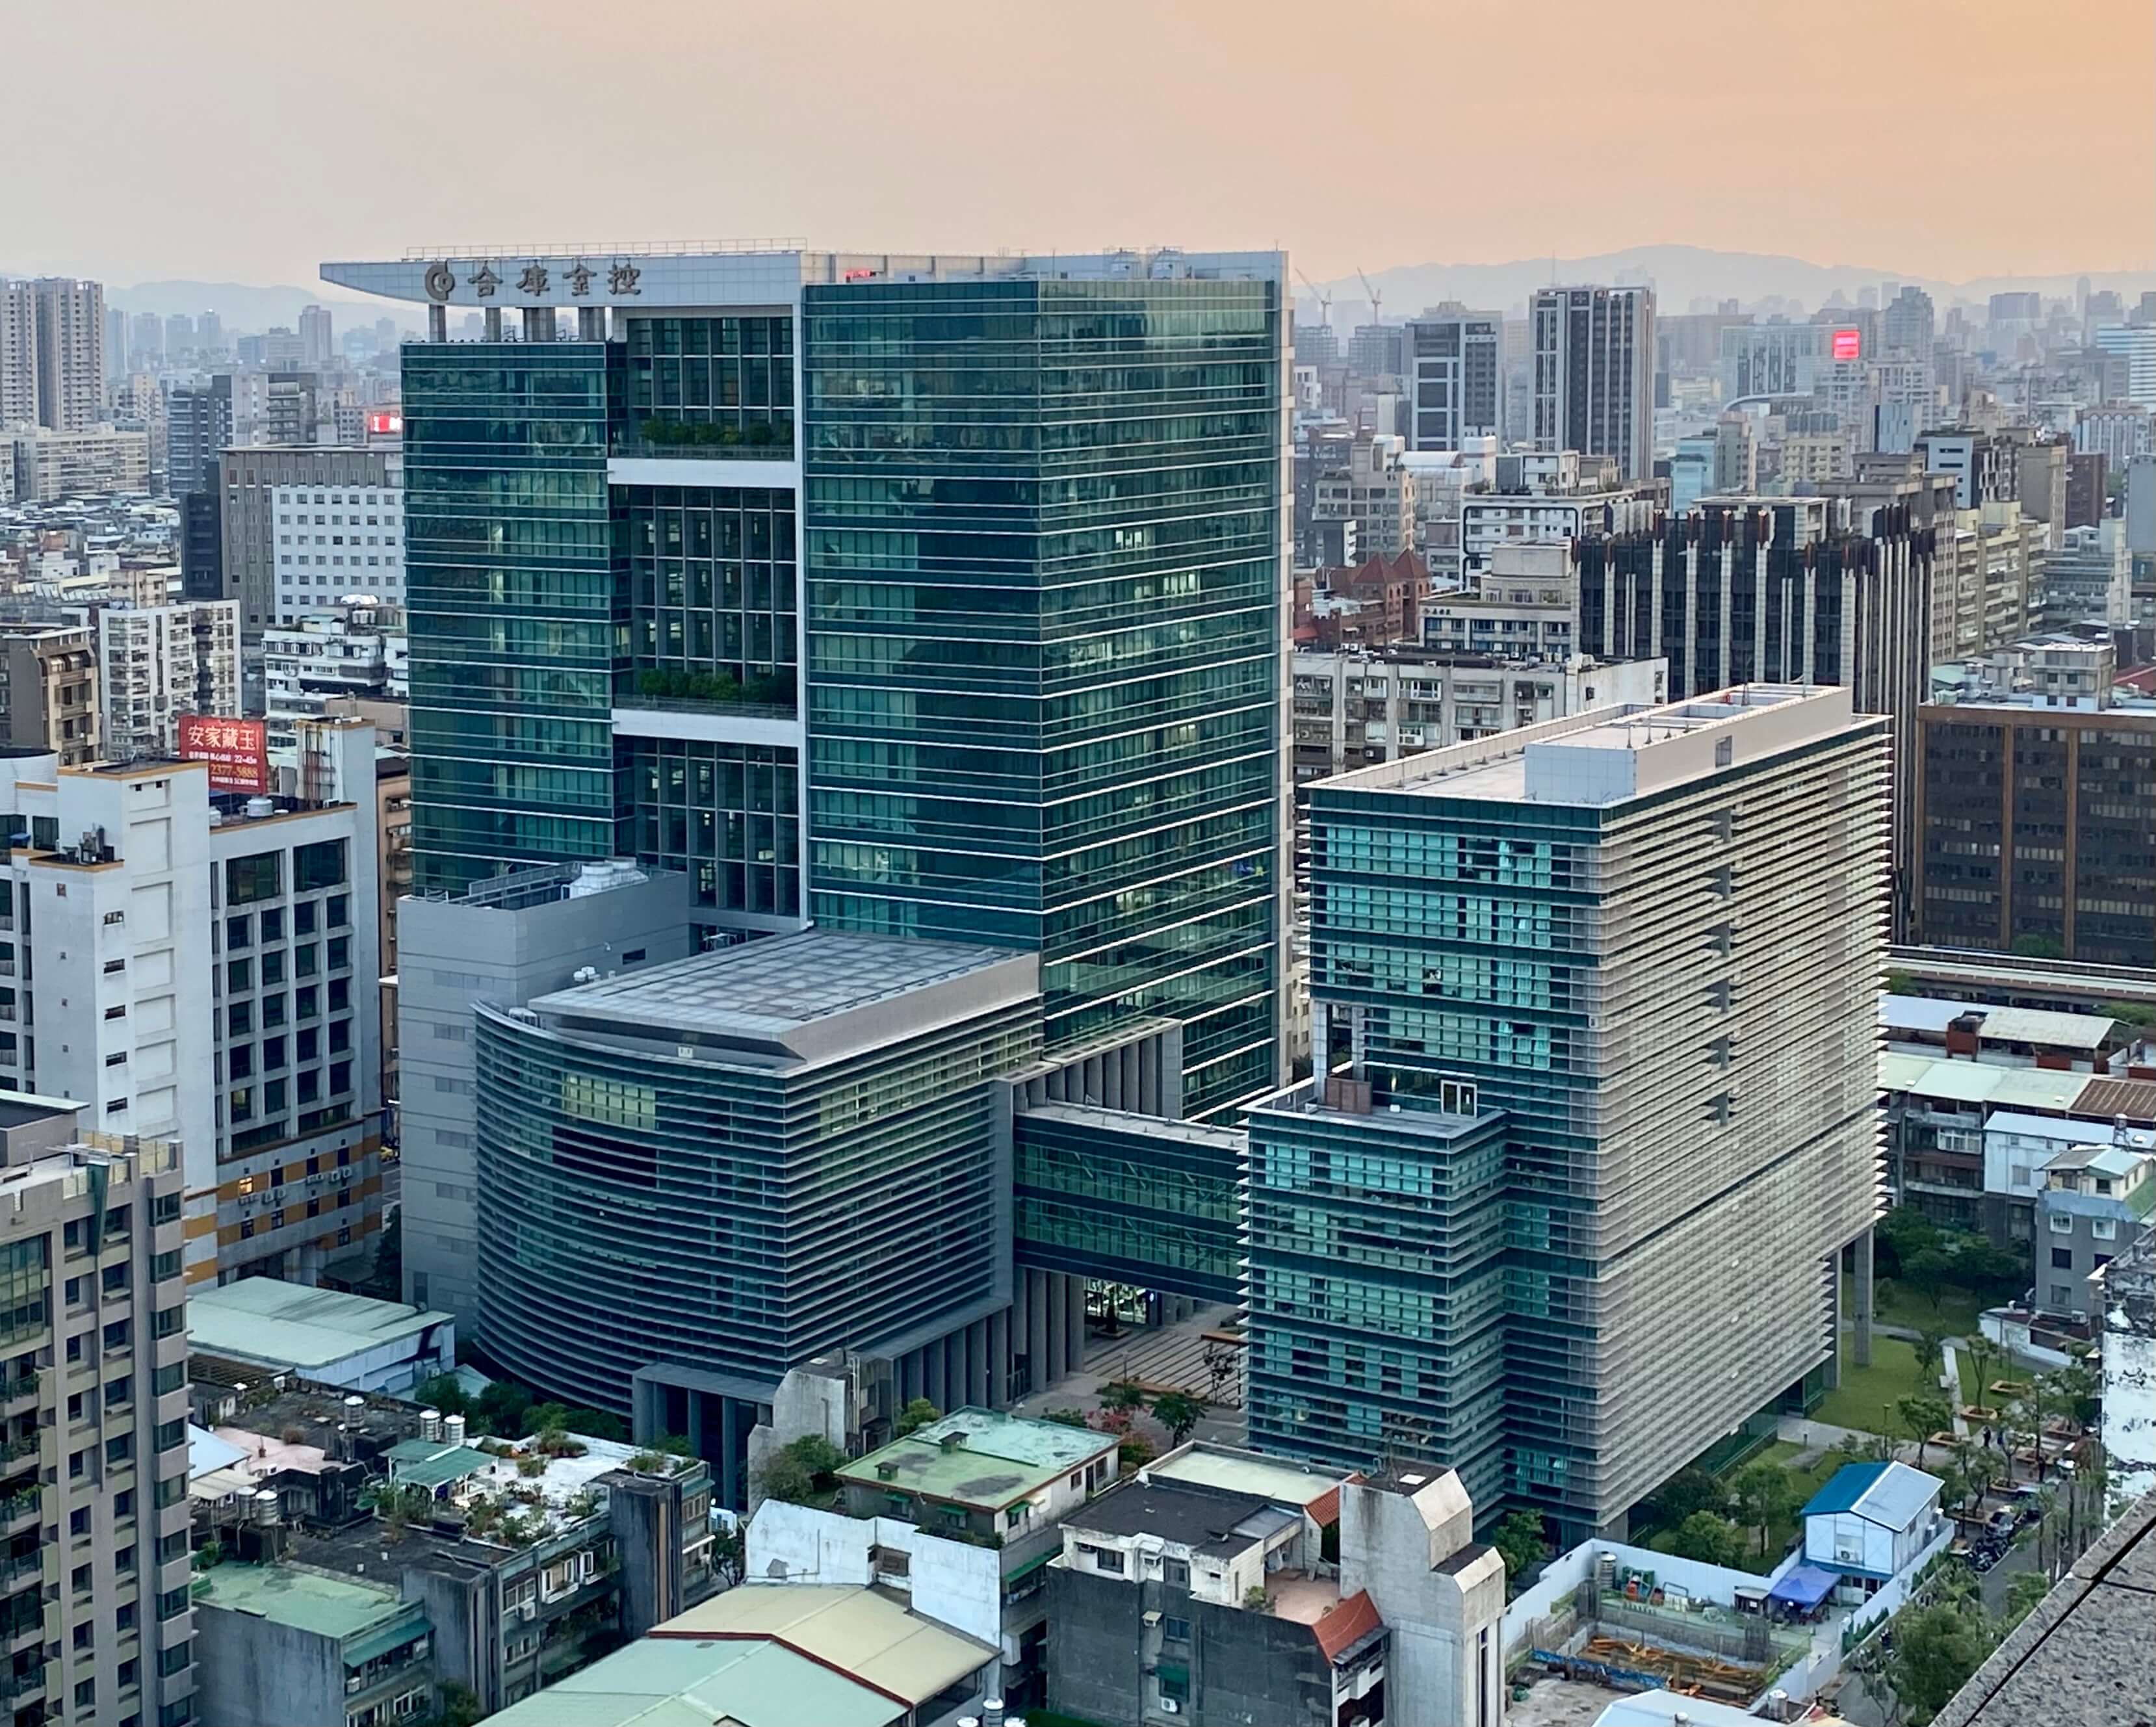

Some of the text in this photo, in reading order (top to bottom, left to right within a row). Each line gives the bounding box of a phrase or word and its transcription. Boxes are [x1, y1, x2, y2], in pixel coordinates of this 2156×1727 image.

[467, 263, 642, 298] 合庫金控
[188, 724, 256, 751] 安家藏玉
